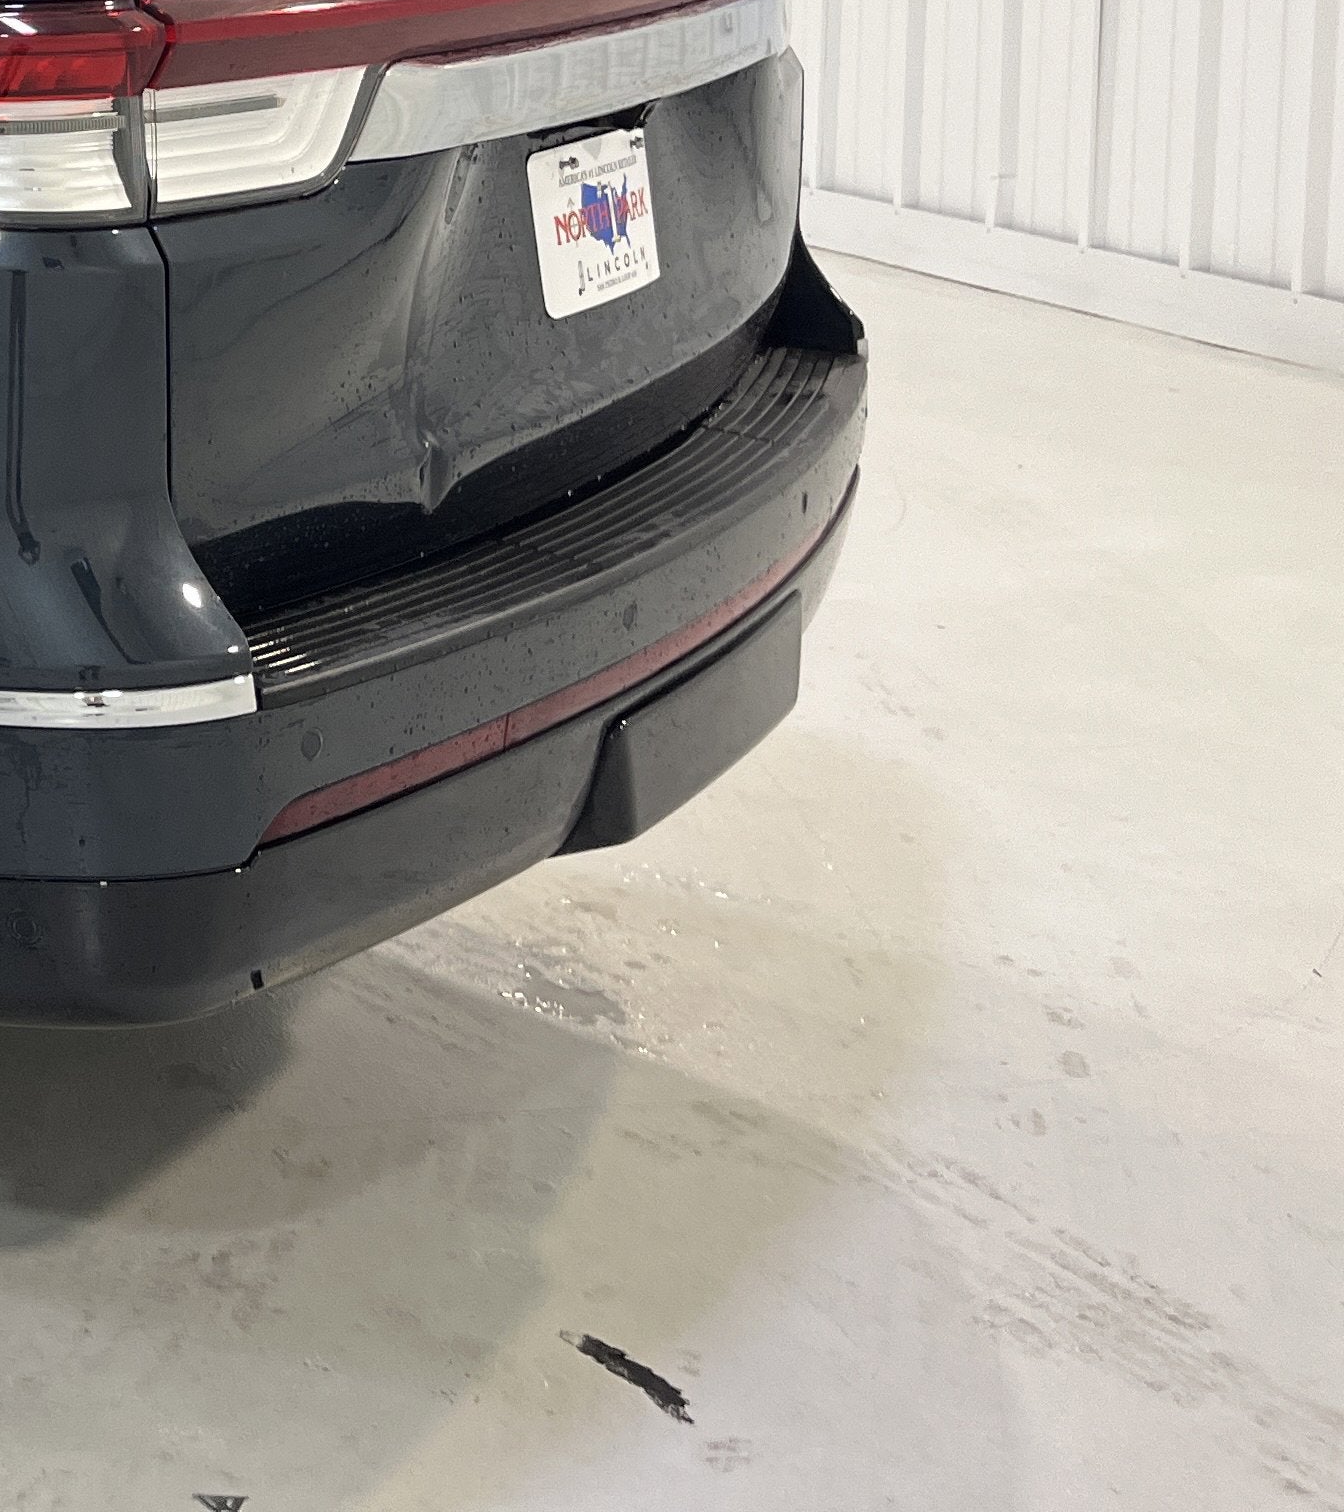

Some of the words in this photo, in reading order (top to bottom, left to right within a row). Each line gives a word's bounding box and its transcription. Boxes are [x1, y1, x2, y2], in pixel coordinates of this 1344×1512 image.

[553, 200, 611, 246] NORTH
[615, 187, 649, 224] PARK
[586, 246, 646, 283] LINCOLN
